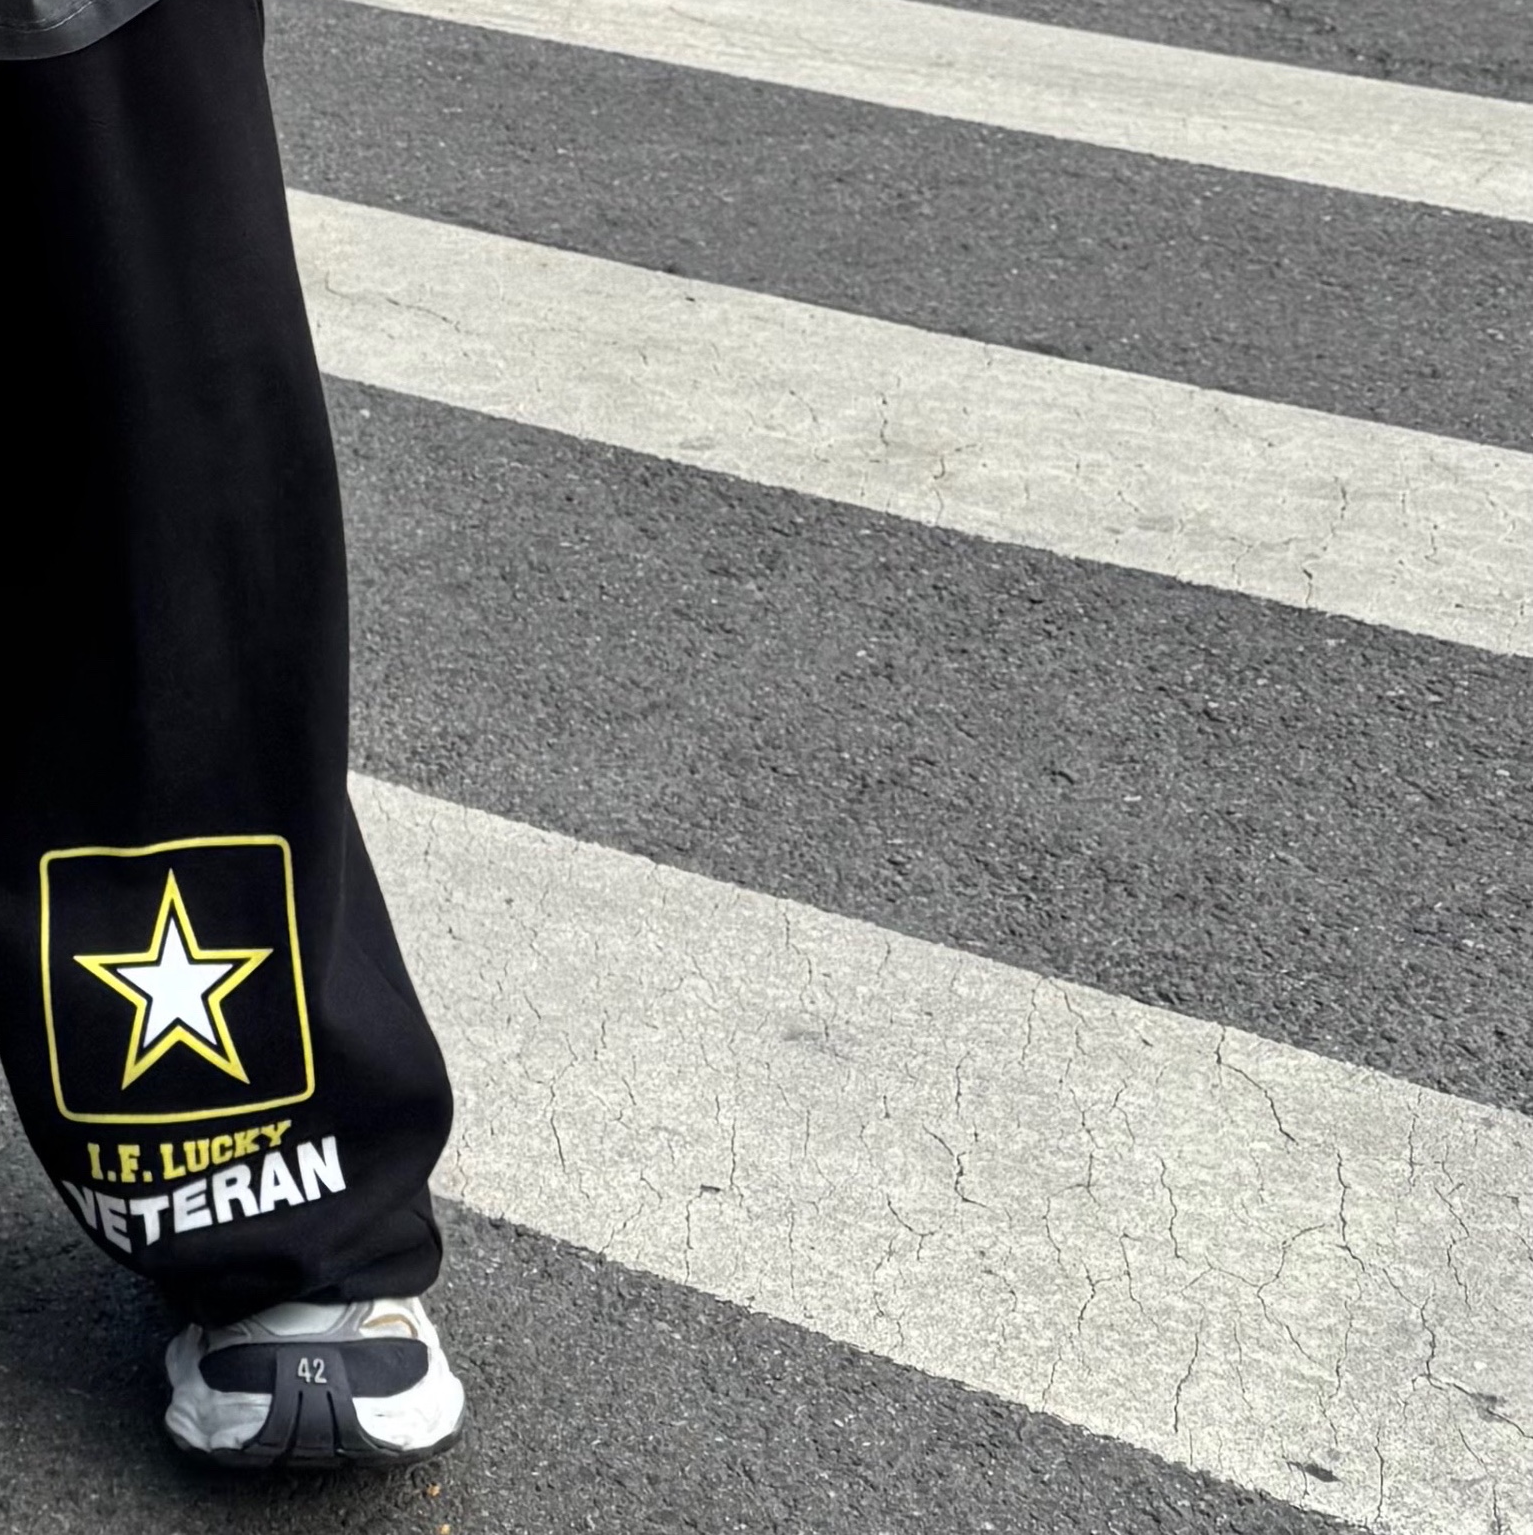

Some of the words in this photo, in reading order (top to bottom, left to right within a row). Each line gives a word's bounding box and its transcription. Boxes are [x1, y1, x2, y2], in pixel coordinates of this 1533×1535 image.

[87, 1142, 153, 1183] I.F.
[160, 1119, 292, 1181] LUCKY
[297, 1357, 328, 1385] 42
